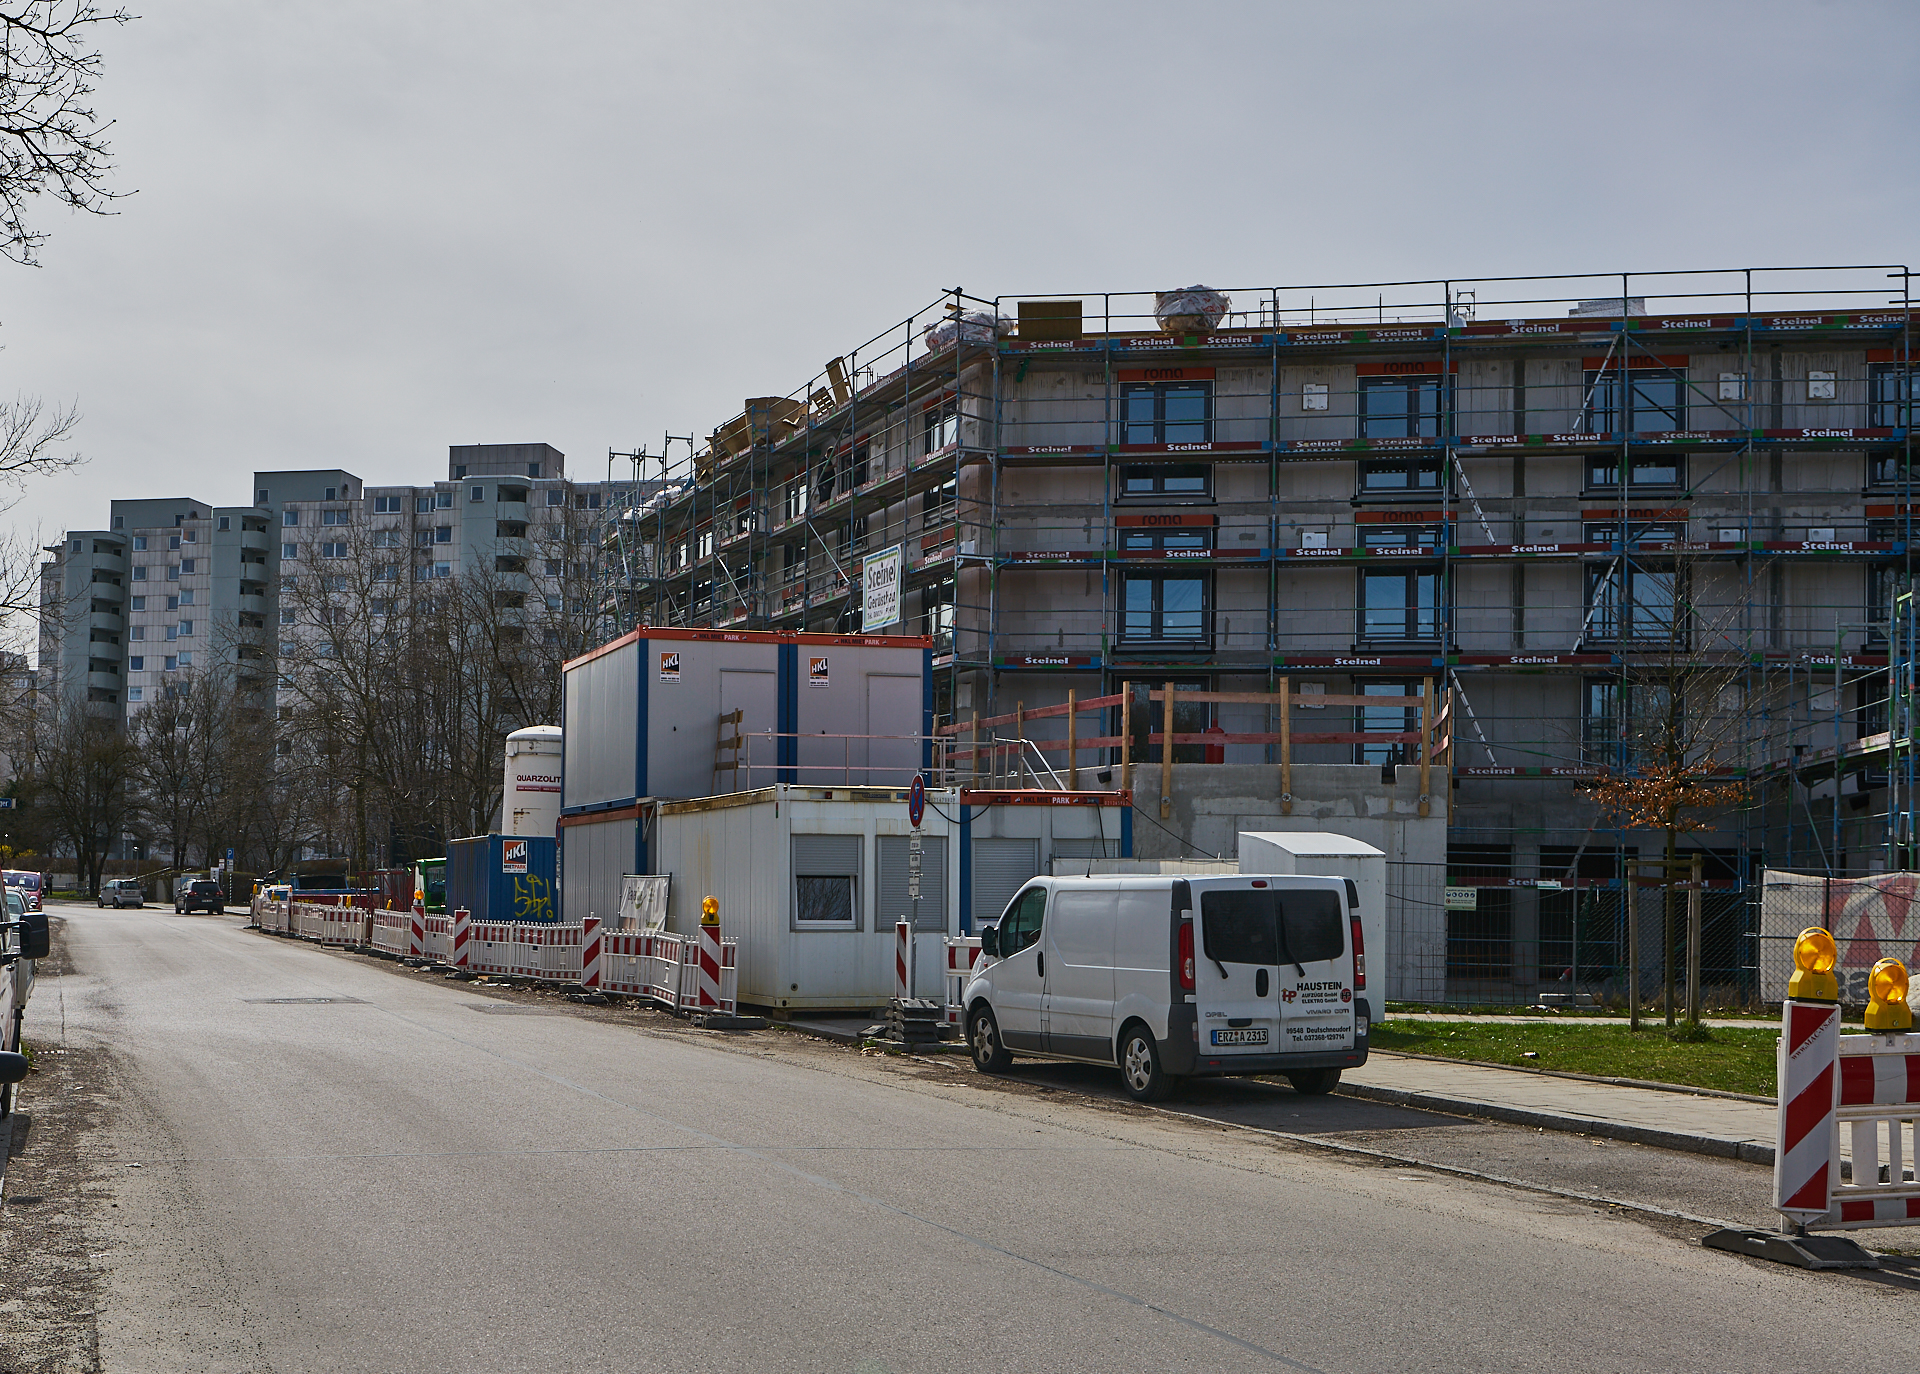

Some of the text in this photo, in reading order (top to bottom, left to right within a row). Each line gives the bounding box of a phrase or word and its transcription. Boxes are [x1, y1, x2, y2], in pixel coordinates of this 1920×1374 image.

[1661, 319, 1711, 329] Steinel
[1772, 317, 1822, 325] Steinel
[1511, 324, 1559, 333] Steinel
[1295, 332, 1341, 341] Steinel
[1376, 330, 1422, 338] Steinel
[1130, 338, 1174, 346] Steinel
[1207, 336, 1252, 344] Steinel
[1384, 362, 1424, 373] roma
[1144, 368, 1183, 379] roma
[1662, 431, 1710, 439] Steinel
[1802, 428, 1853, 437] Steinel
[1471, 436, 1517, 444] Steinel
[1553, 433, 1601, 441] Steinel
[1167, 443, 1212, 451] Steinel
[1296, 440, 1342, 448] Steinel
[1142, 514, 1182, 525] roma
[1383, 512, 1423, 522] roma
[1511, 544, 1559, 553] Steinel
[1801, 541, 1853, 550] Steinel
[1026, 551, 1070, 559] Steinel
[1166, 550, 1211, 558] Steinel
[1296, 548, 1342, 556] Steinel
[868, 559, 895, 589] Steinel
[663, 653, 678, 668] HKL
[1510, 656, 1558, 664] Steinel
[812, 658, 827, 673] HKL
[1468, 767, 1515, 775] Steinel
[1551, 767, 1599, 775] Steinel
[516, 775, 561, 783] QUARZOLIT
[506, 842, 525, 860] HKL
[1297, 982, 1342, 991] HAUSTEIN
[1341, 992, 1351, 1000] HP
[1218, 1031, 1267, 1042] ERZ A 2313
[1791, 1015, 1835, 1061] www.MAC-VS.de
